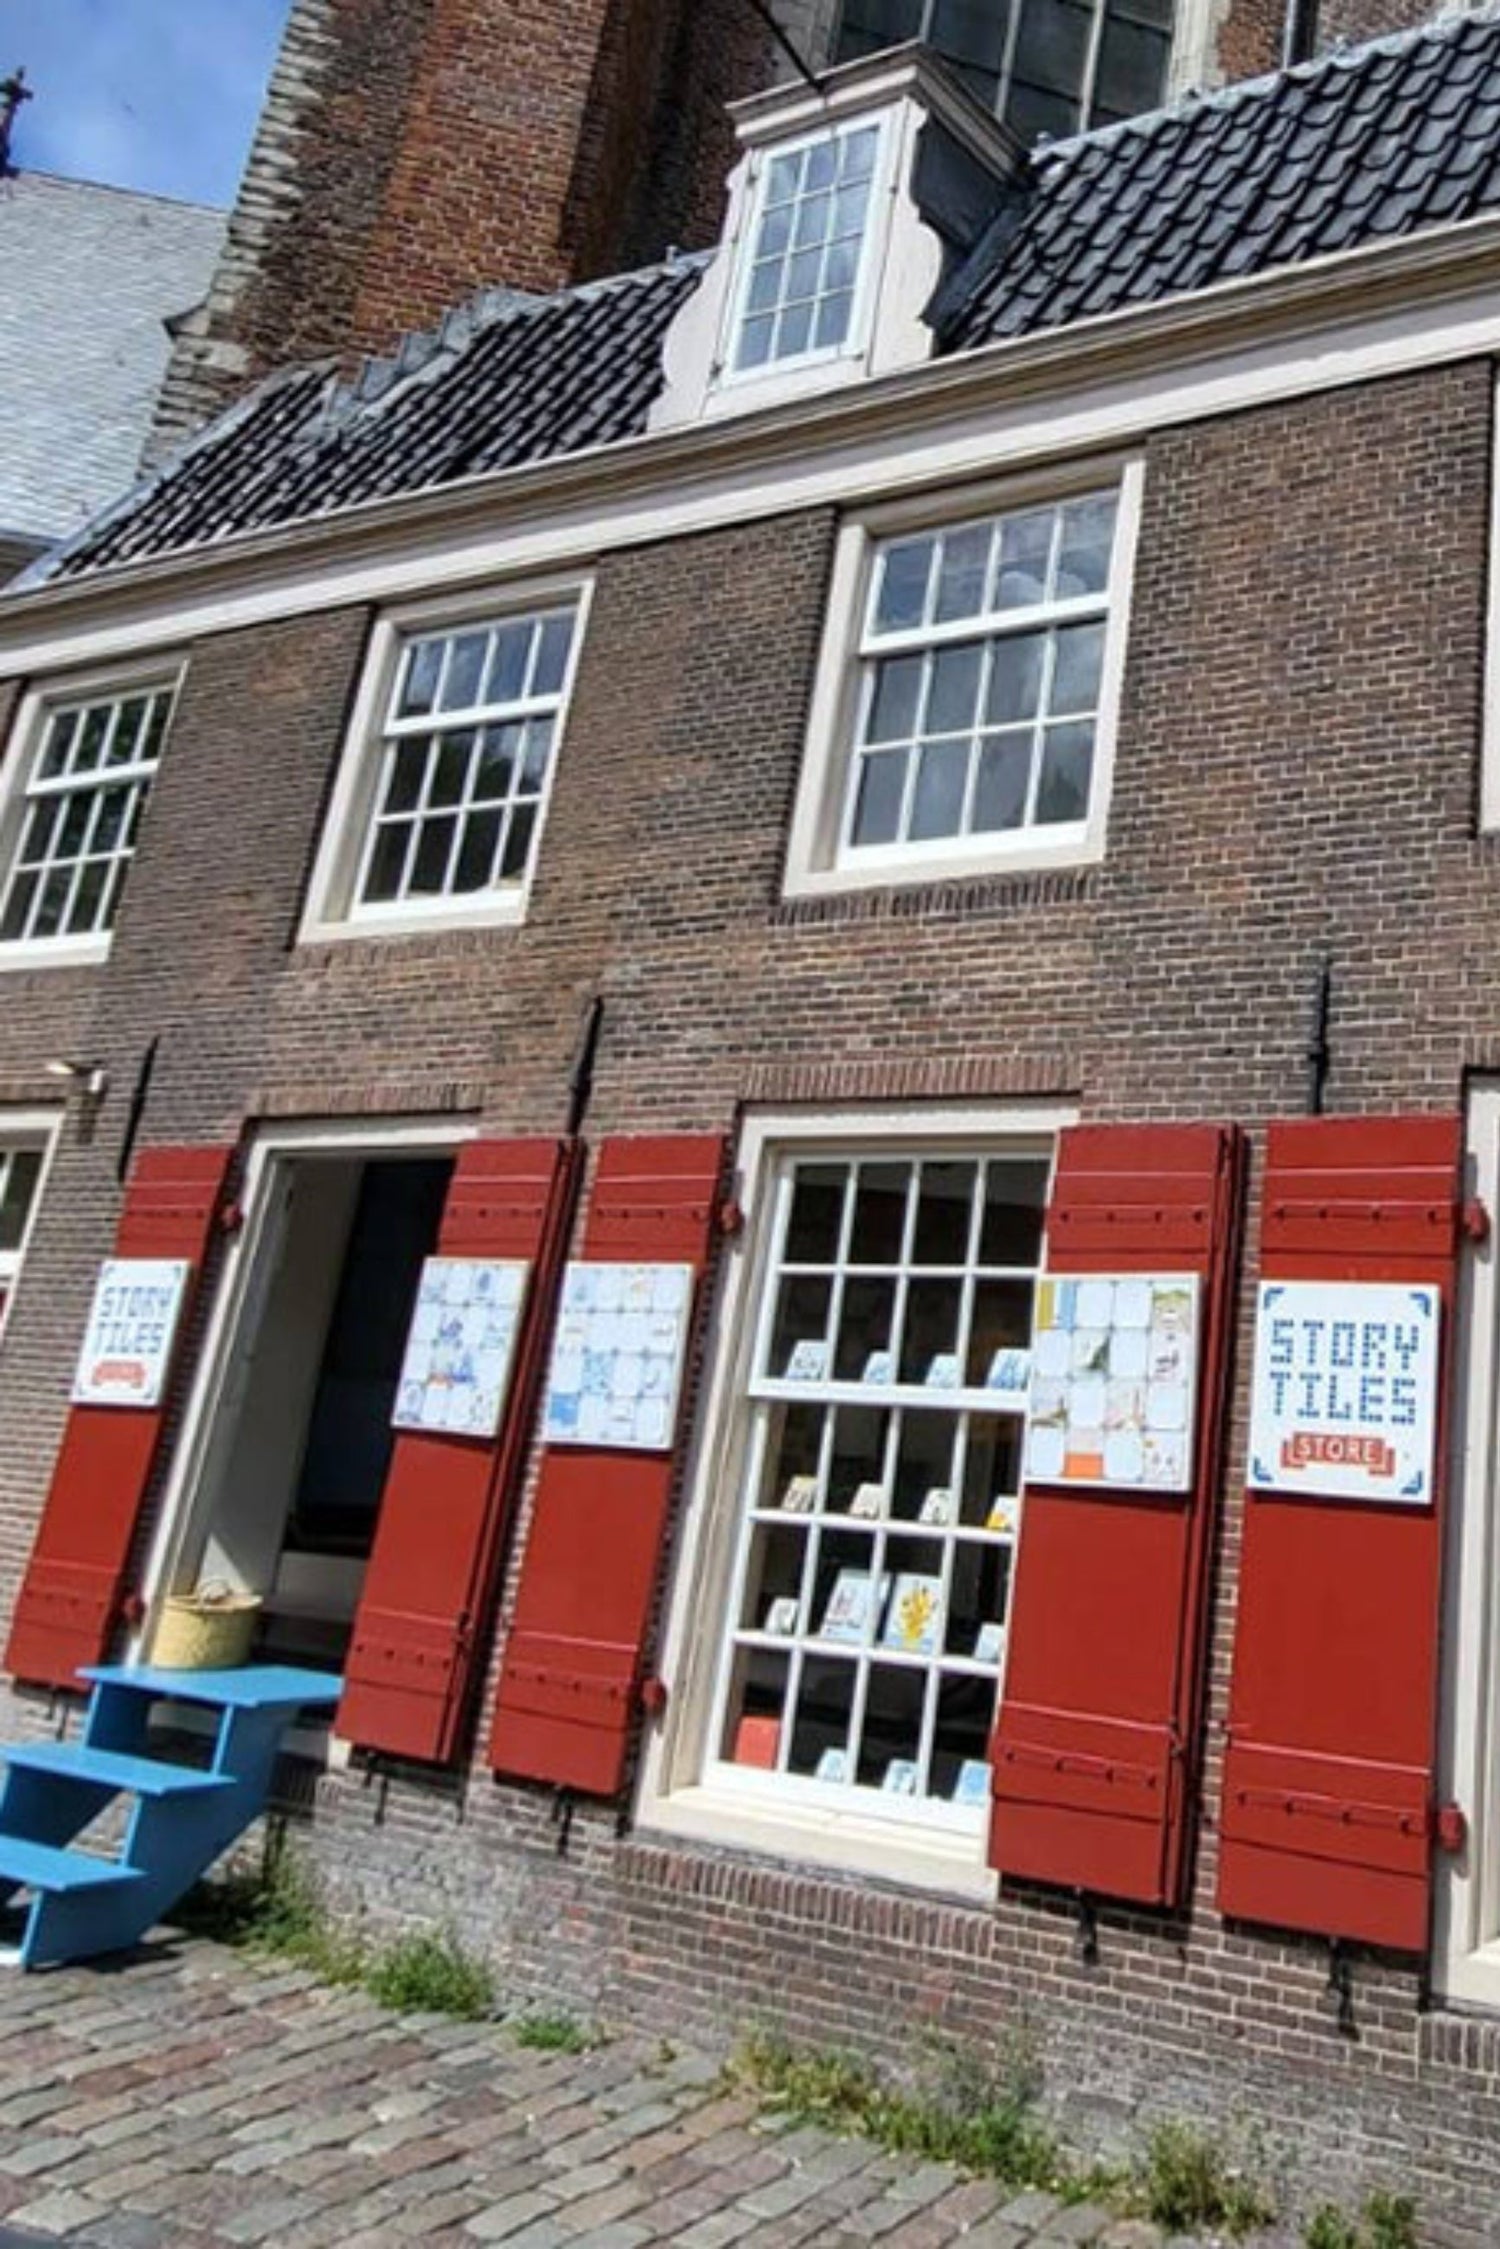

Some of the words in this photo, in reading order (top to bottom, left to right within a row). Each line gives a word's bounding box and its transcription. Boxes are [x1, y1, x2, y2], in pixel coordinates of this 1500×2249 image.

[1270, 1318, 1419, 1370] STORY
[1269, 1371, 1416, 1425] TILES
[1299, 1437, 1377, 1463] STORE
